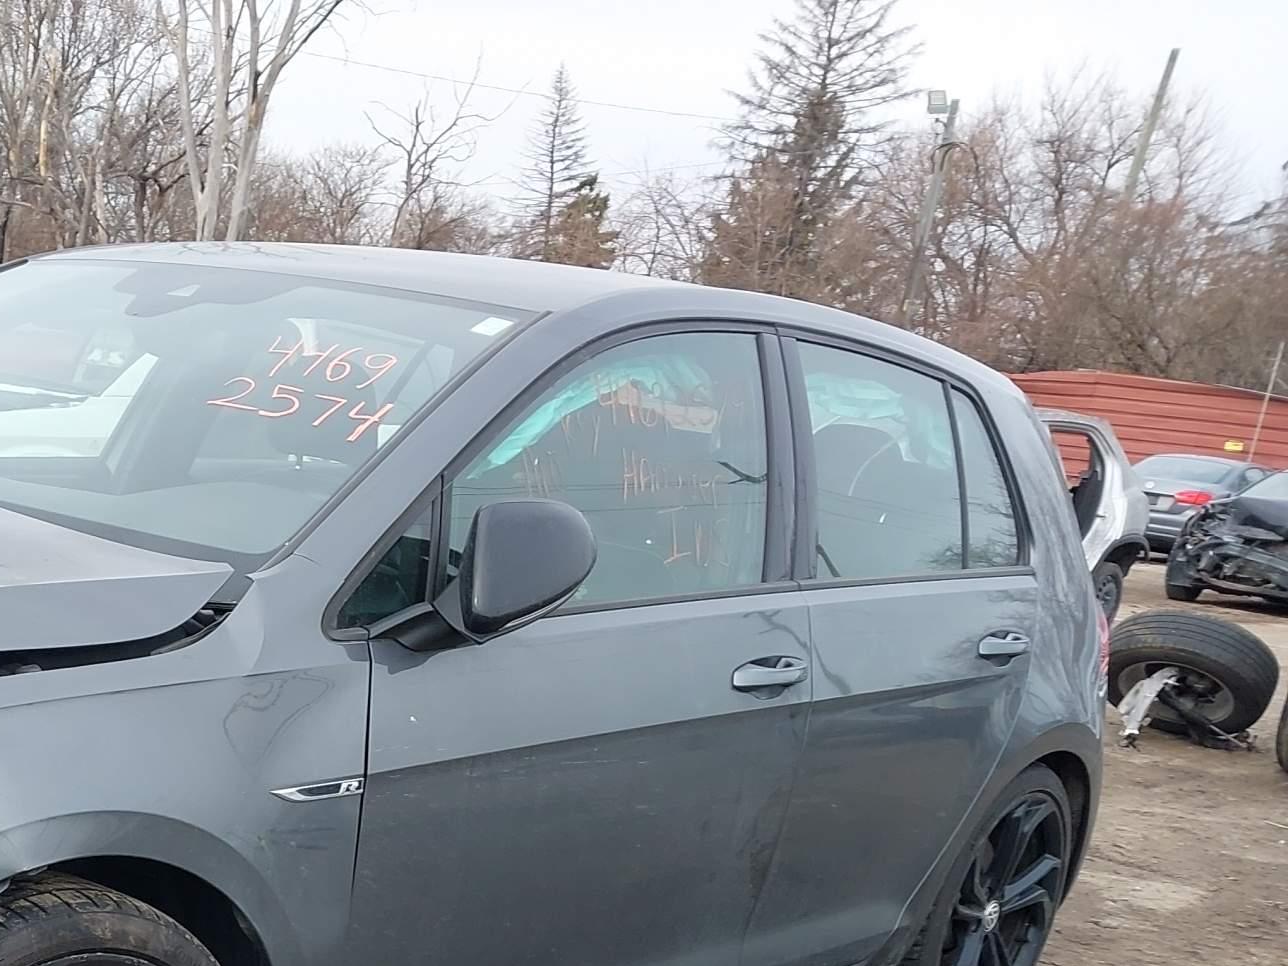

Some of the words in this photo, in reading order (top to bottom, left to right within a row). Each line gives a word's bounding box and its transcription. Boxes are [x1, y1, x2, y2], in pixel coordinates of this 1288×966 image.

[268, 335, 398, 389] 4469
[206, 376, 395, 442] 2574
[338, 781, 360, 795] R
